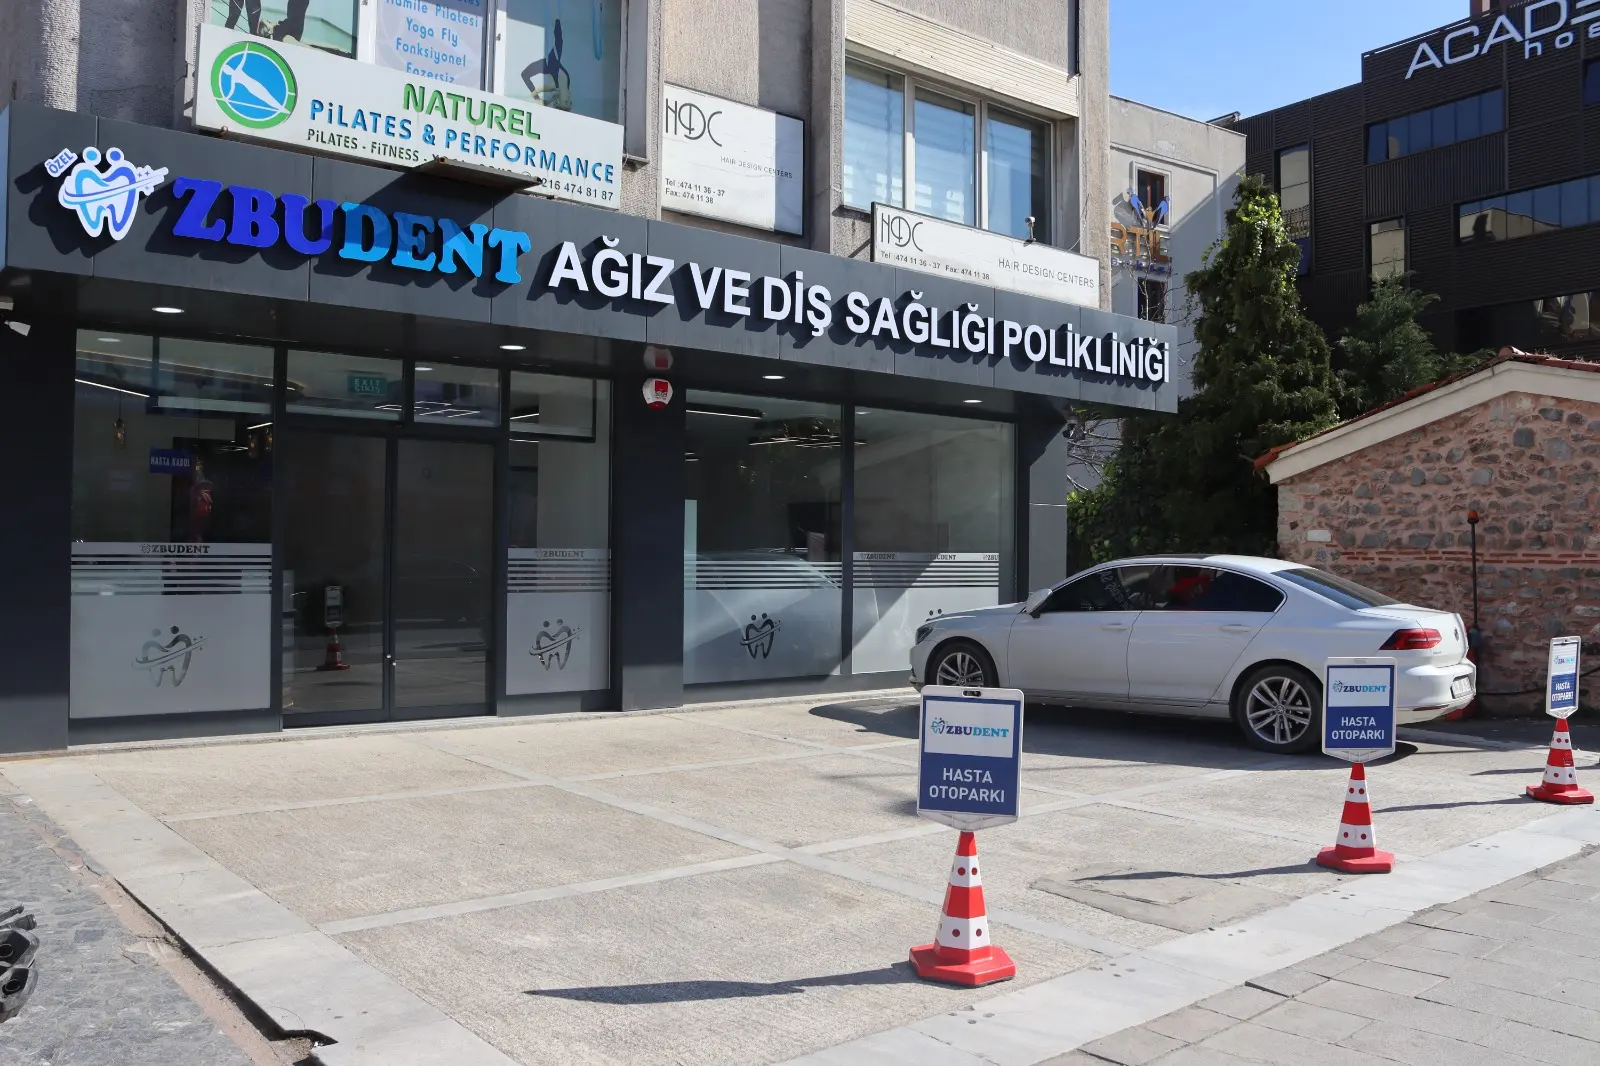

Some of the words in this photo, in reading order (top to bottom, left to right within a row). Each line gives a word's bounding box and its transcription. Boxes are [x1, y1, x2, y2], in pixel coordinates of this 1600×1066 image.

[436, 4, 479, 28] Pilatesi
[406, 17, 434, 39] Yoga
[441, 28, 458, 47] Fly
[396, 37, 466, 67] Fonksiyonel
[403, 83, 541, 140] NATUREL
[46, 151, 74, 174] ÖZEL
[422, 124, 436, 146] &
[445, 129, 615, 184] PERFORMANCE
[720, 156, 736, 165] HAIR
[738, 161, 762, 172] DESIGN
[763, 167, 793, 179] CENTERS
[564, 182, 583, 195] 474
[586, 187, 598, 199] 81
[601, 191, 614, 202] 87
[682, 191, 695, 200] 474
[172, 177, 532, 284] ZBUDENT
[933, 261, 941, 269] 37
[961, 268, 972, 276] 474
[982, 272, 990, 280] 38
[998, 258, 1020, 271] HAIR
[1022, 264, 1055, 279] DESIGN
[1057, 271, 1095, 289] CENTERS
[548, 235, 675, 304] AĞIZ
[690, 262, 751, 316] VE
[763, 270, 832, 337] DİŞ
[845, 290, 994, 355] SAĞLIĞI
[1003, 320, 1170, 383] POLİKLİNİĞİ
[354, 378, 380, 387] EXIT
[151, 456, 170, 466] HASTA
[152, 544, 210, 554] ZBUDENT
[1343, 685, 1388, 693] ZBUDENT
[1341, 716, 1376, 727] HASTA
[945, 725, 1010, 738] ZBUDENT
[1331, 730, 1385, 740] OTOPARKI
[943, 768, 993, 784] HASTA
[929, 785, 1005, 803] OTOPARKI
